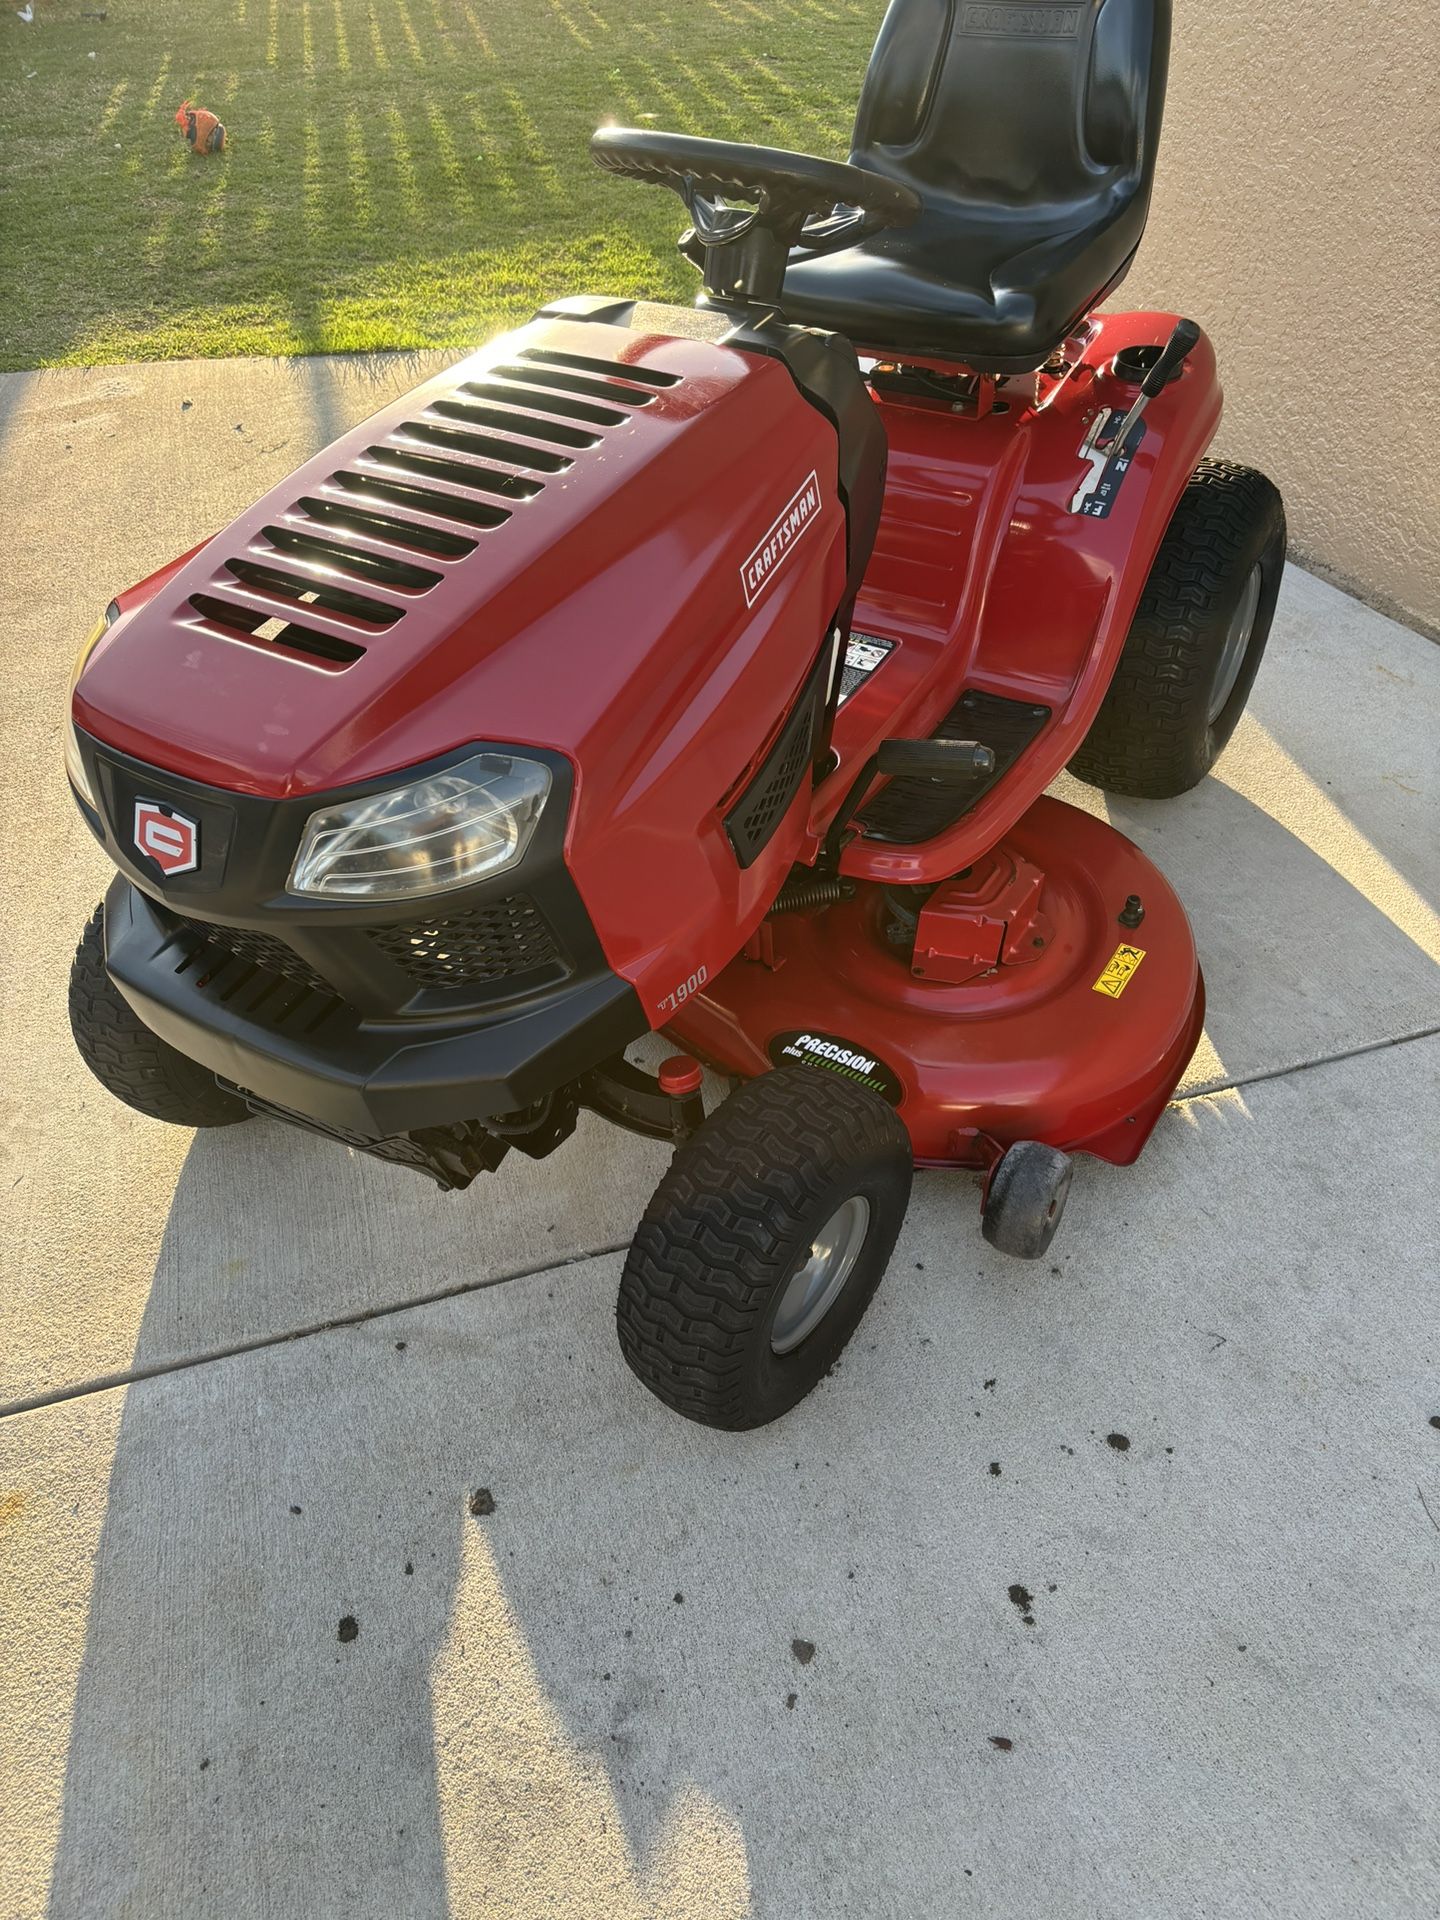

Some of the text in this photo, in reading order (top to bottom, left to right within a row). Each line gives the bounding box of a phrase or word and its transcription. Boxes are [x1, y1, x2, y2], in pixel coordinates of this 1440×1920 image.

[965, 6, 1078, 34] CRAFTSMAN
[748, 486, 816, 590] CRAFTSMAN
[781, 1044, 804, 1058] plus
[794, 1034, 876, 1075] PRECISION
